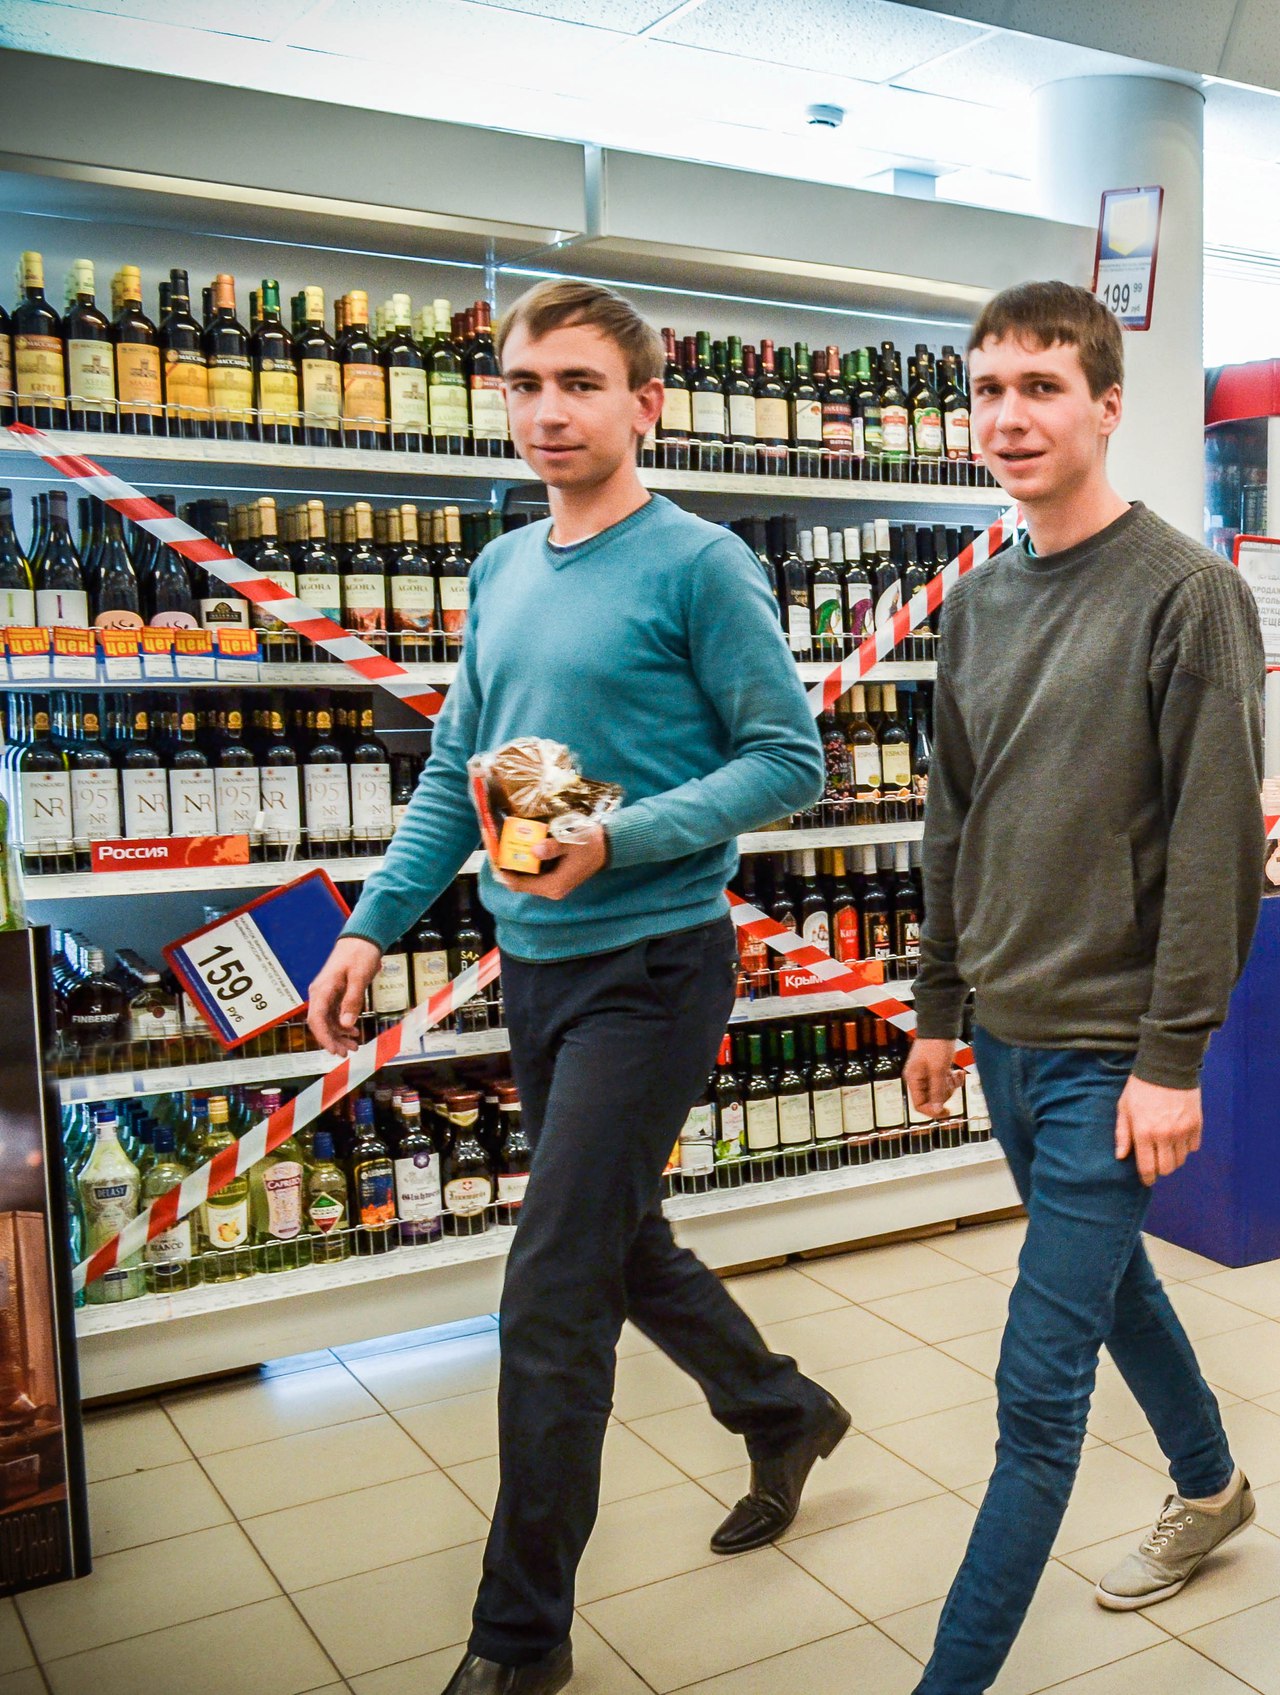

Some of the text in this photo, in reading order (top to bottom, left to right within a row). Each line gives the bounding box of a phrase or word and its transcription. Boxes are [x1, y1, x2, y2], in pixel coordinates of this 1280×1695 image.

[1103, 283, 1143, 313] 199 99
[137, 793, 167, 814] NR
[183, 793, 213, 814] NR
[99, 846, 168, 860] Россия
[198, 945, 253, 1001] 159
[250, 993, 268, 1011] 99
[785, 975, 824, 989] Крым
[72, 1013, 120, 1023] FINBERRY
[226, 1006, 245, 1023] руб
